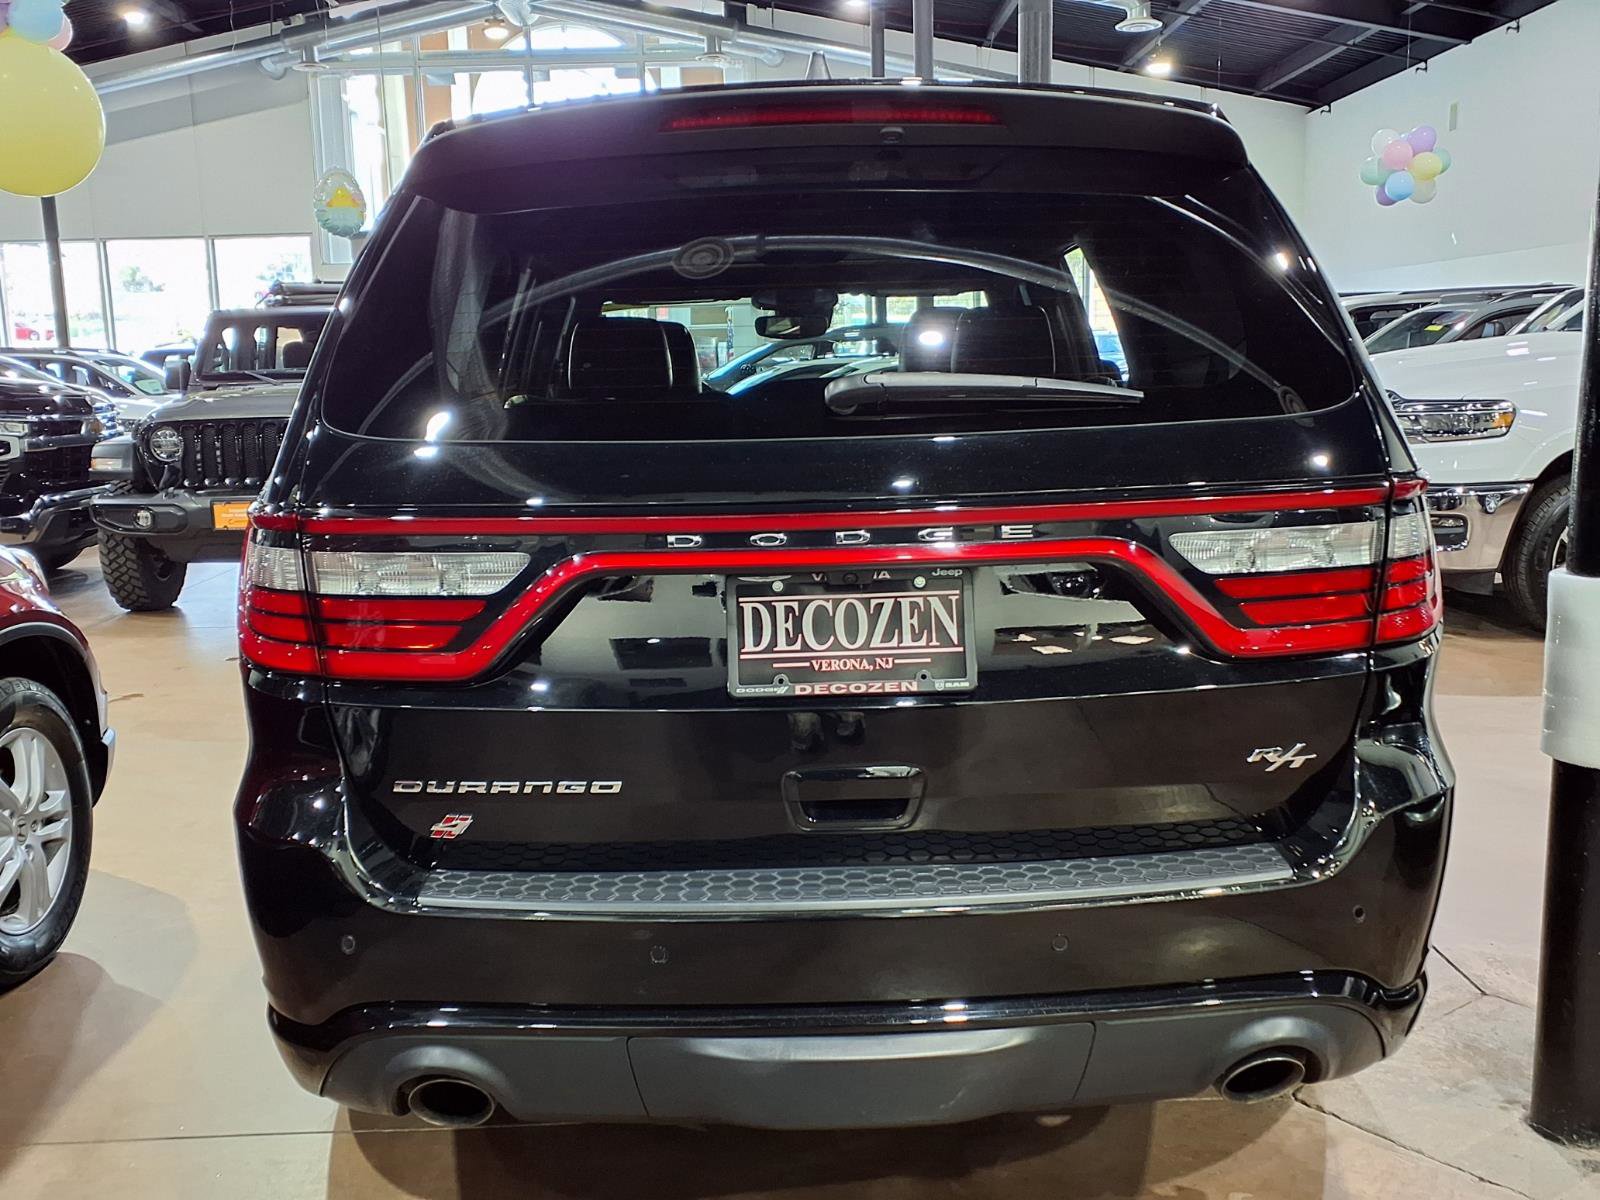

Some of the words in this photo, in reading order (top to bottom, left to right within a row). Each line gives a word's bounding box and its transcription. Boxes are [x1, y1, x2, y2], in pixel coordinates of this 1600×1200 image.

[666, 524, 1034, 548] DODGE
[931, 567, 963, 577] Jeep
[739, 595, 960, 653] DECOZEN
[811, 658, 873, 671] VERONA,
[875, 657, 894, 669] NJ
[794, 681, 918, 695] DECOZEN
[1246, 742, 1317, 772] R/T
[392, 780, 622, 794] DURANGO
